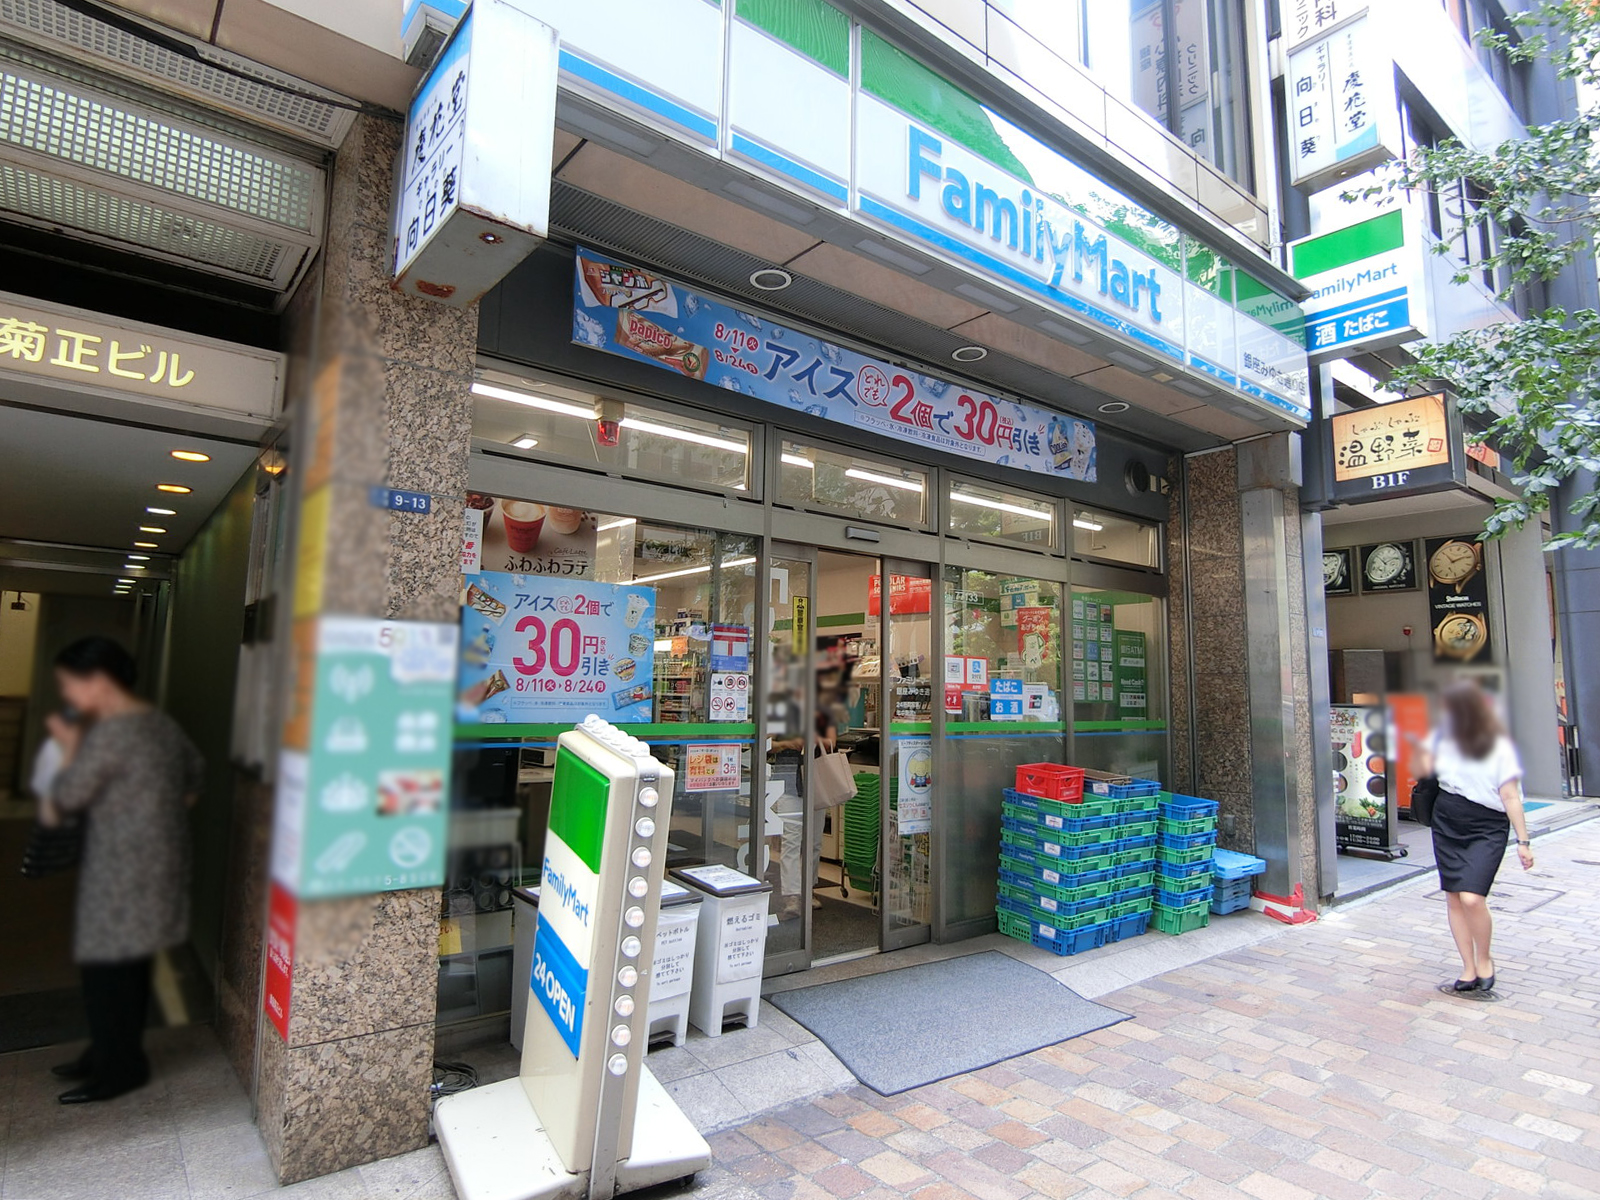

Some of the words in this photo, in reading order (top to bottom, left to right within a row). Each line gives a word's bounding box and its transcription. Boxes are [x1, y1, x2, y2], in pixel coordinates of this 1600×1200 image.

[1315, 43, 1326, 91] ギャラリー
[1296, 76, 1317, 158] 向日葵
[405, 165, 458, 259] 向日葵
[907, 123, 1163, 324] FamilyMart
[1303, 263, 1398, 302] amilyMart
[629, 318, 672, 350] papico
[1315, 322, 1337, 346] 酒
[1343, 310, 1389, 337] たばこ
[0, 317, 195, 387] 菊正ビル
[763, 341, 858, 407] アイス
[1338, 428, 1424, 469] 温野菜
[1370, 470, 1411, 490] B1F
[504, 556, 589, 576] ふわふわラテ
[514, 593, 557, 612] アイス
[574, 594, 614, 616] 2個で
[582, 657, 610, 676] 引き
[995, 680, 1018, 692] たばこ
[542, 857, 589, 927] FamilyMart
[726, 913, 760, 925] 燃えるゴミ
